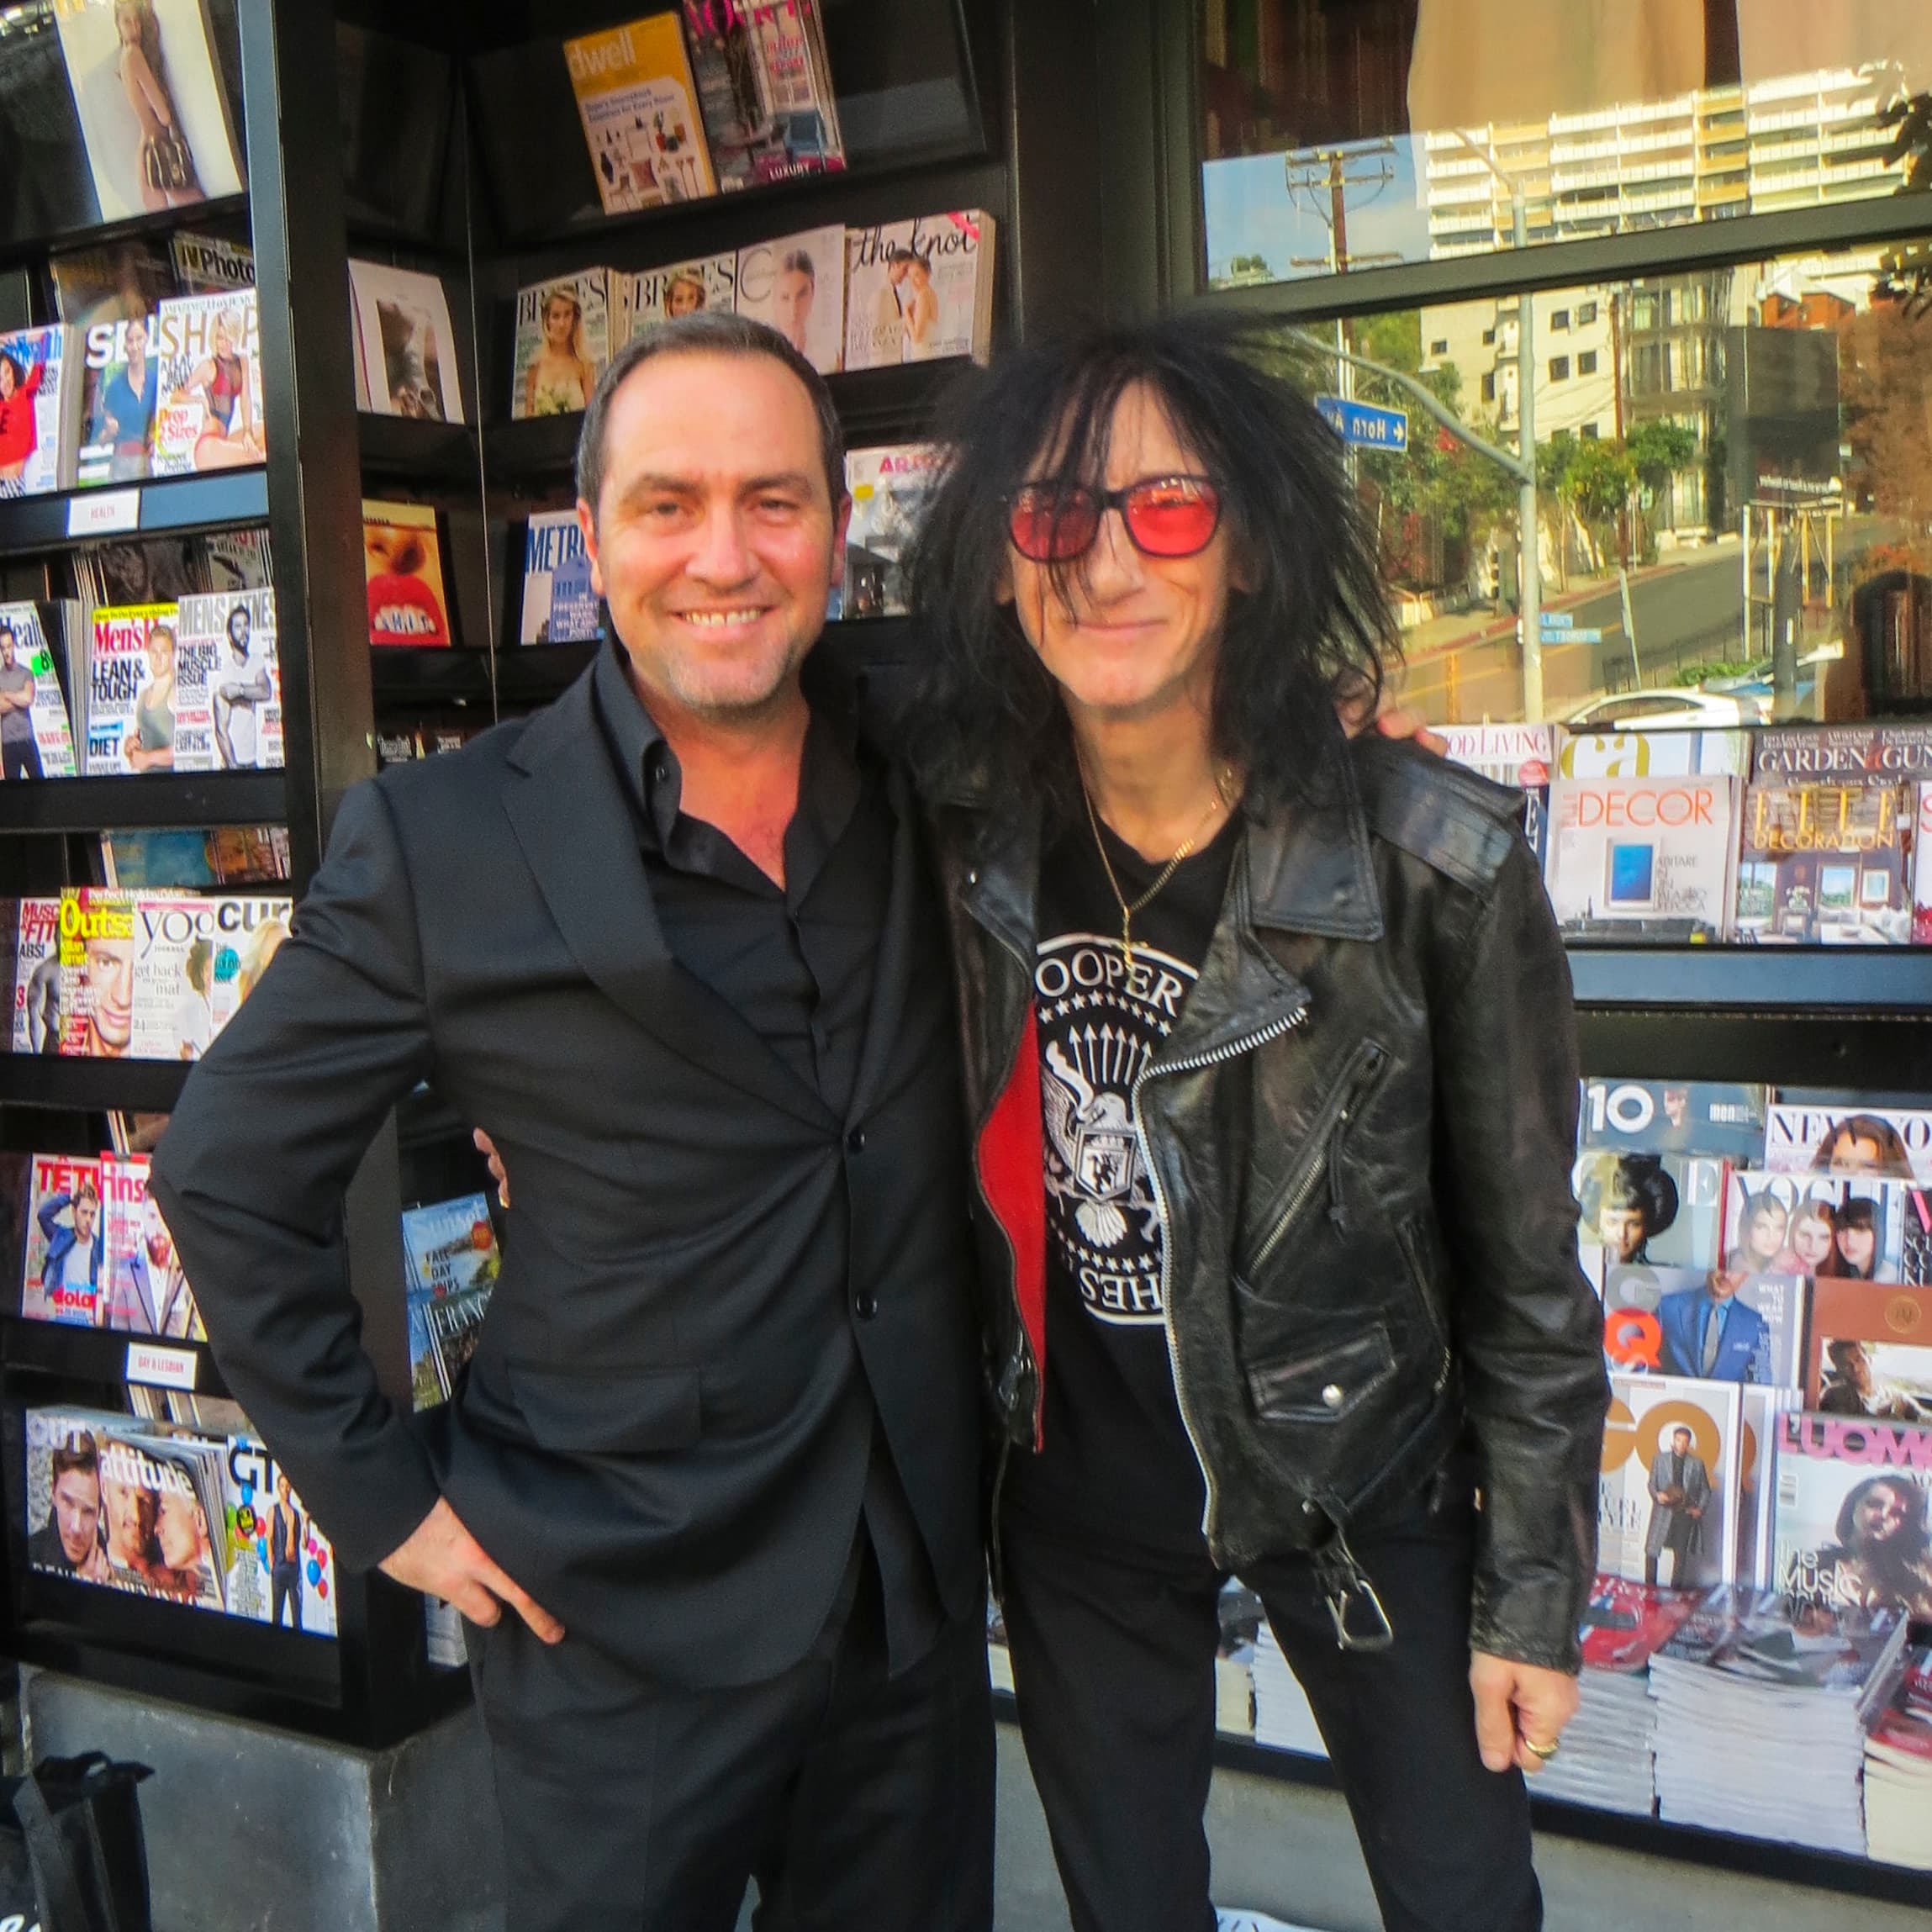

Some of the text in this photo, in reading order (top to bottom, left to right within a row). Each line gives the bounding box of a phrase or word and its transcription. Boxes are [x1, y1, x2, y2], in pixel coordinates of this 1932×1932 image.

[853, 218, 977, 272] the knot
[90, 506, 115, 519] HEALTH
[94, 618, 142, 654] Men's
[92, 658, 145, 681] LEAN &
[178, 657, 222, 672] MUSCLE
[92, 679, 137, 701] TOUGH
[89, 737, 119, 757] DIET
[1481, 726, 1548, 757] LIVING
[1758, 747, 1868, 773] GARDEN
[1578, 788, 1713, 827] DECOR
[1754, 829, 1893, 850] DECORATION
[1035, 948, 1184, 1018] OOPER
[1587, 1085, 1735, 1134] 10 men
[430, 1263, 451, 1280] DAY
[1758, 1284, 1784, 1293] WHAT
[1761, 1313, 1783, 1323] NOW
[99, 1443, 197, 1502] attitude
